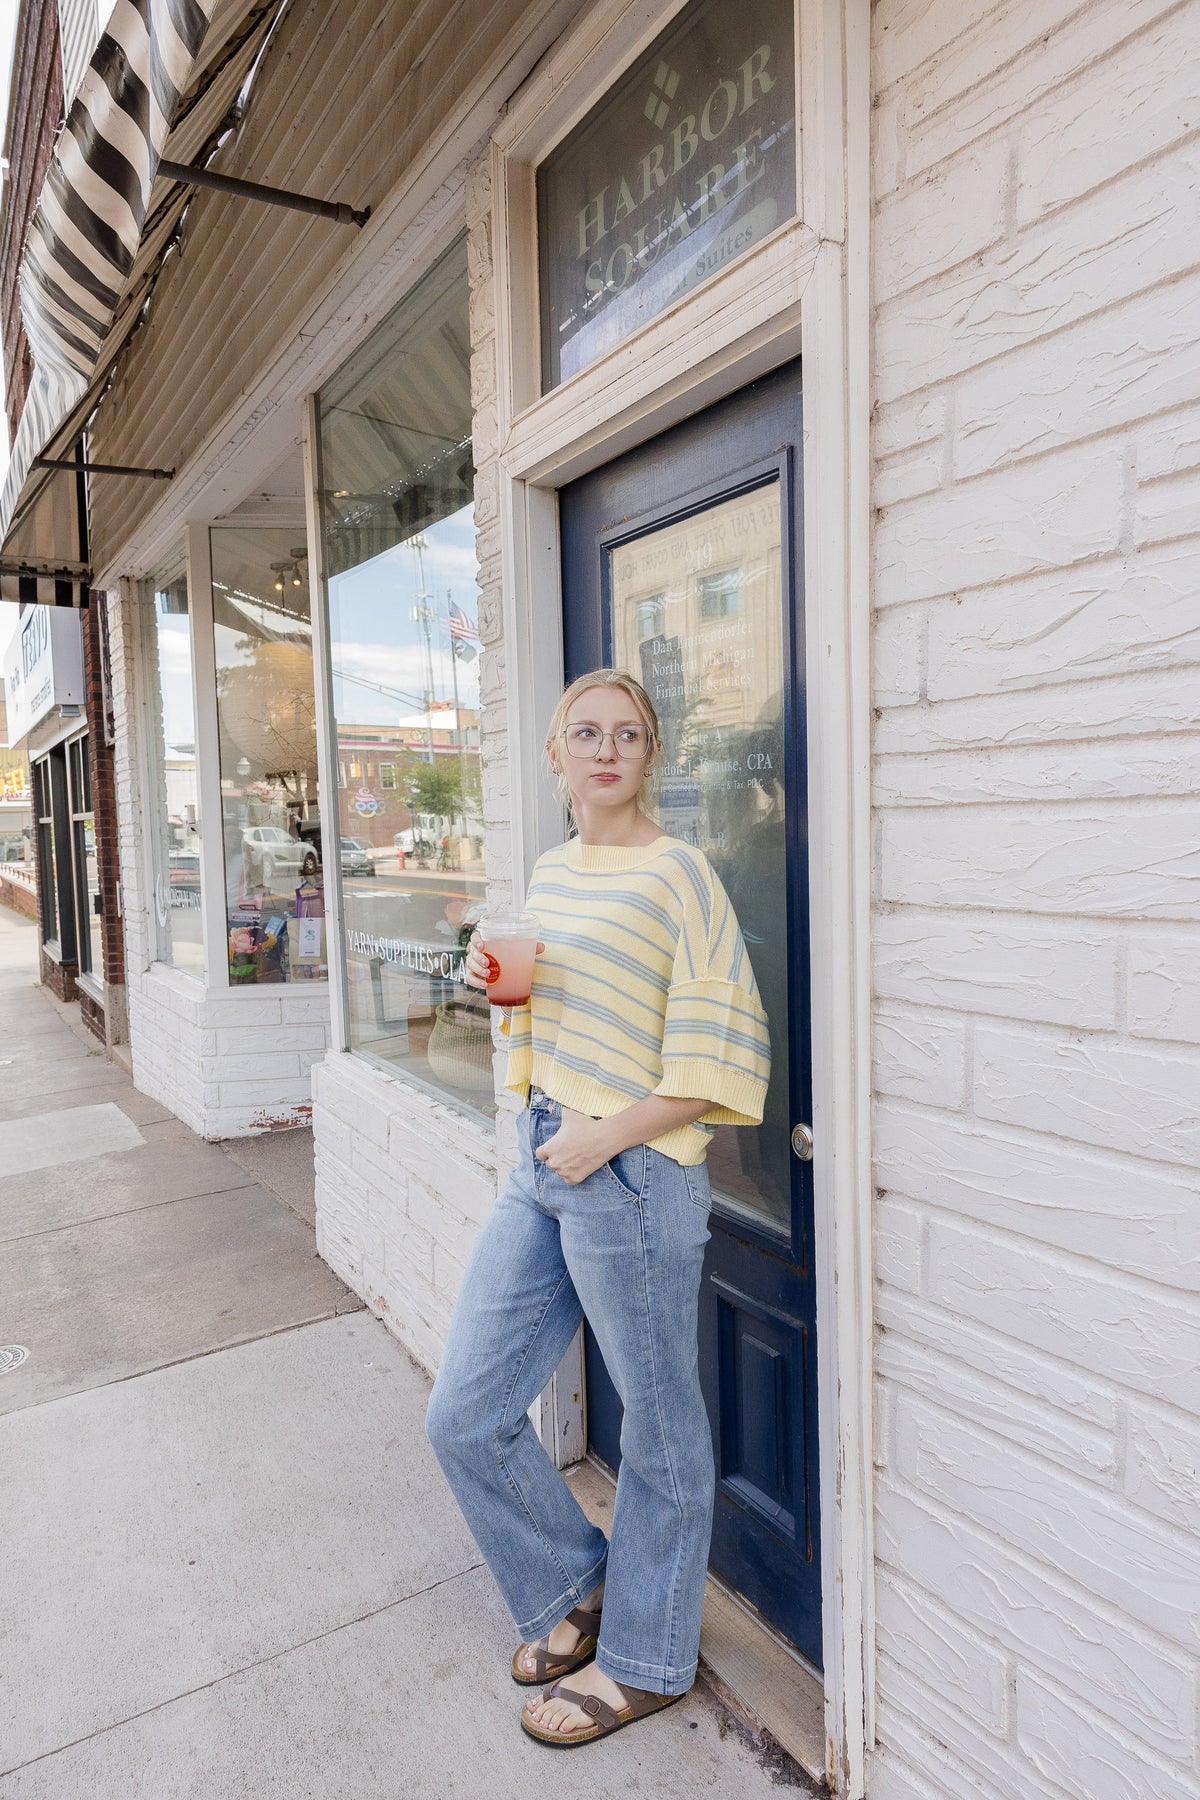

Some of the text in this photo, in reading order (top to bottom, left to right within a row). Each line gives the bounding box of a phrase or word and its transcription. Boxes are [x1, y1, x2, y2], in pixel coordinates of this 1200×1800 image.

[575, 44, 777, 260] HARBOR
[583, 127, 767, 312] SQUARE
[695, 223, 753, 279] Suites
[651, 646, 755, 678] Northern Michigan
[652, 639, 672, 656] Dan
[655, 672, 752, 700] Financial Services
[681, 728, 723, 746] Suite A
[746, 753, 773, 770] CPA
[717, 830, 726, 849] B
[347, 929, 374, 957] YARN
[378, 936, 433, 973] SUPPLIES
